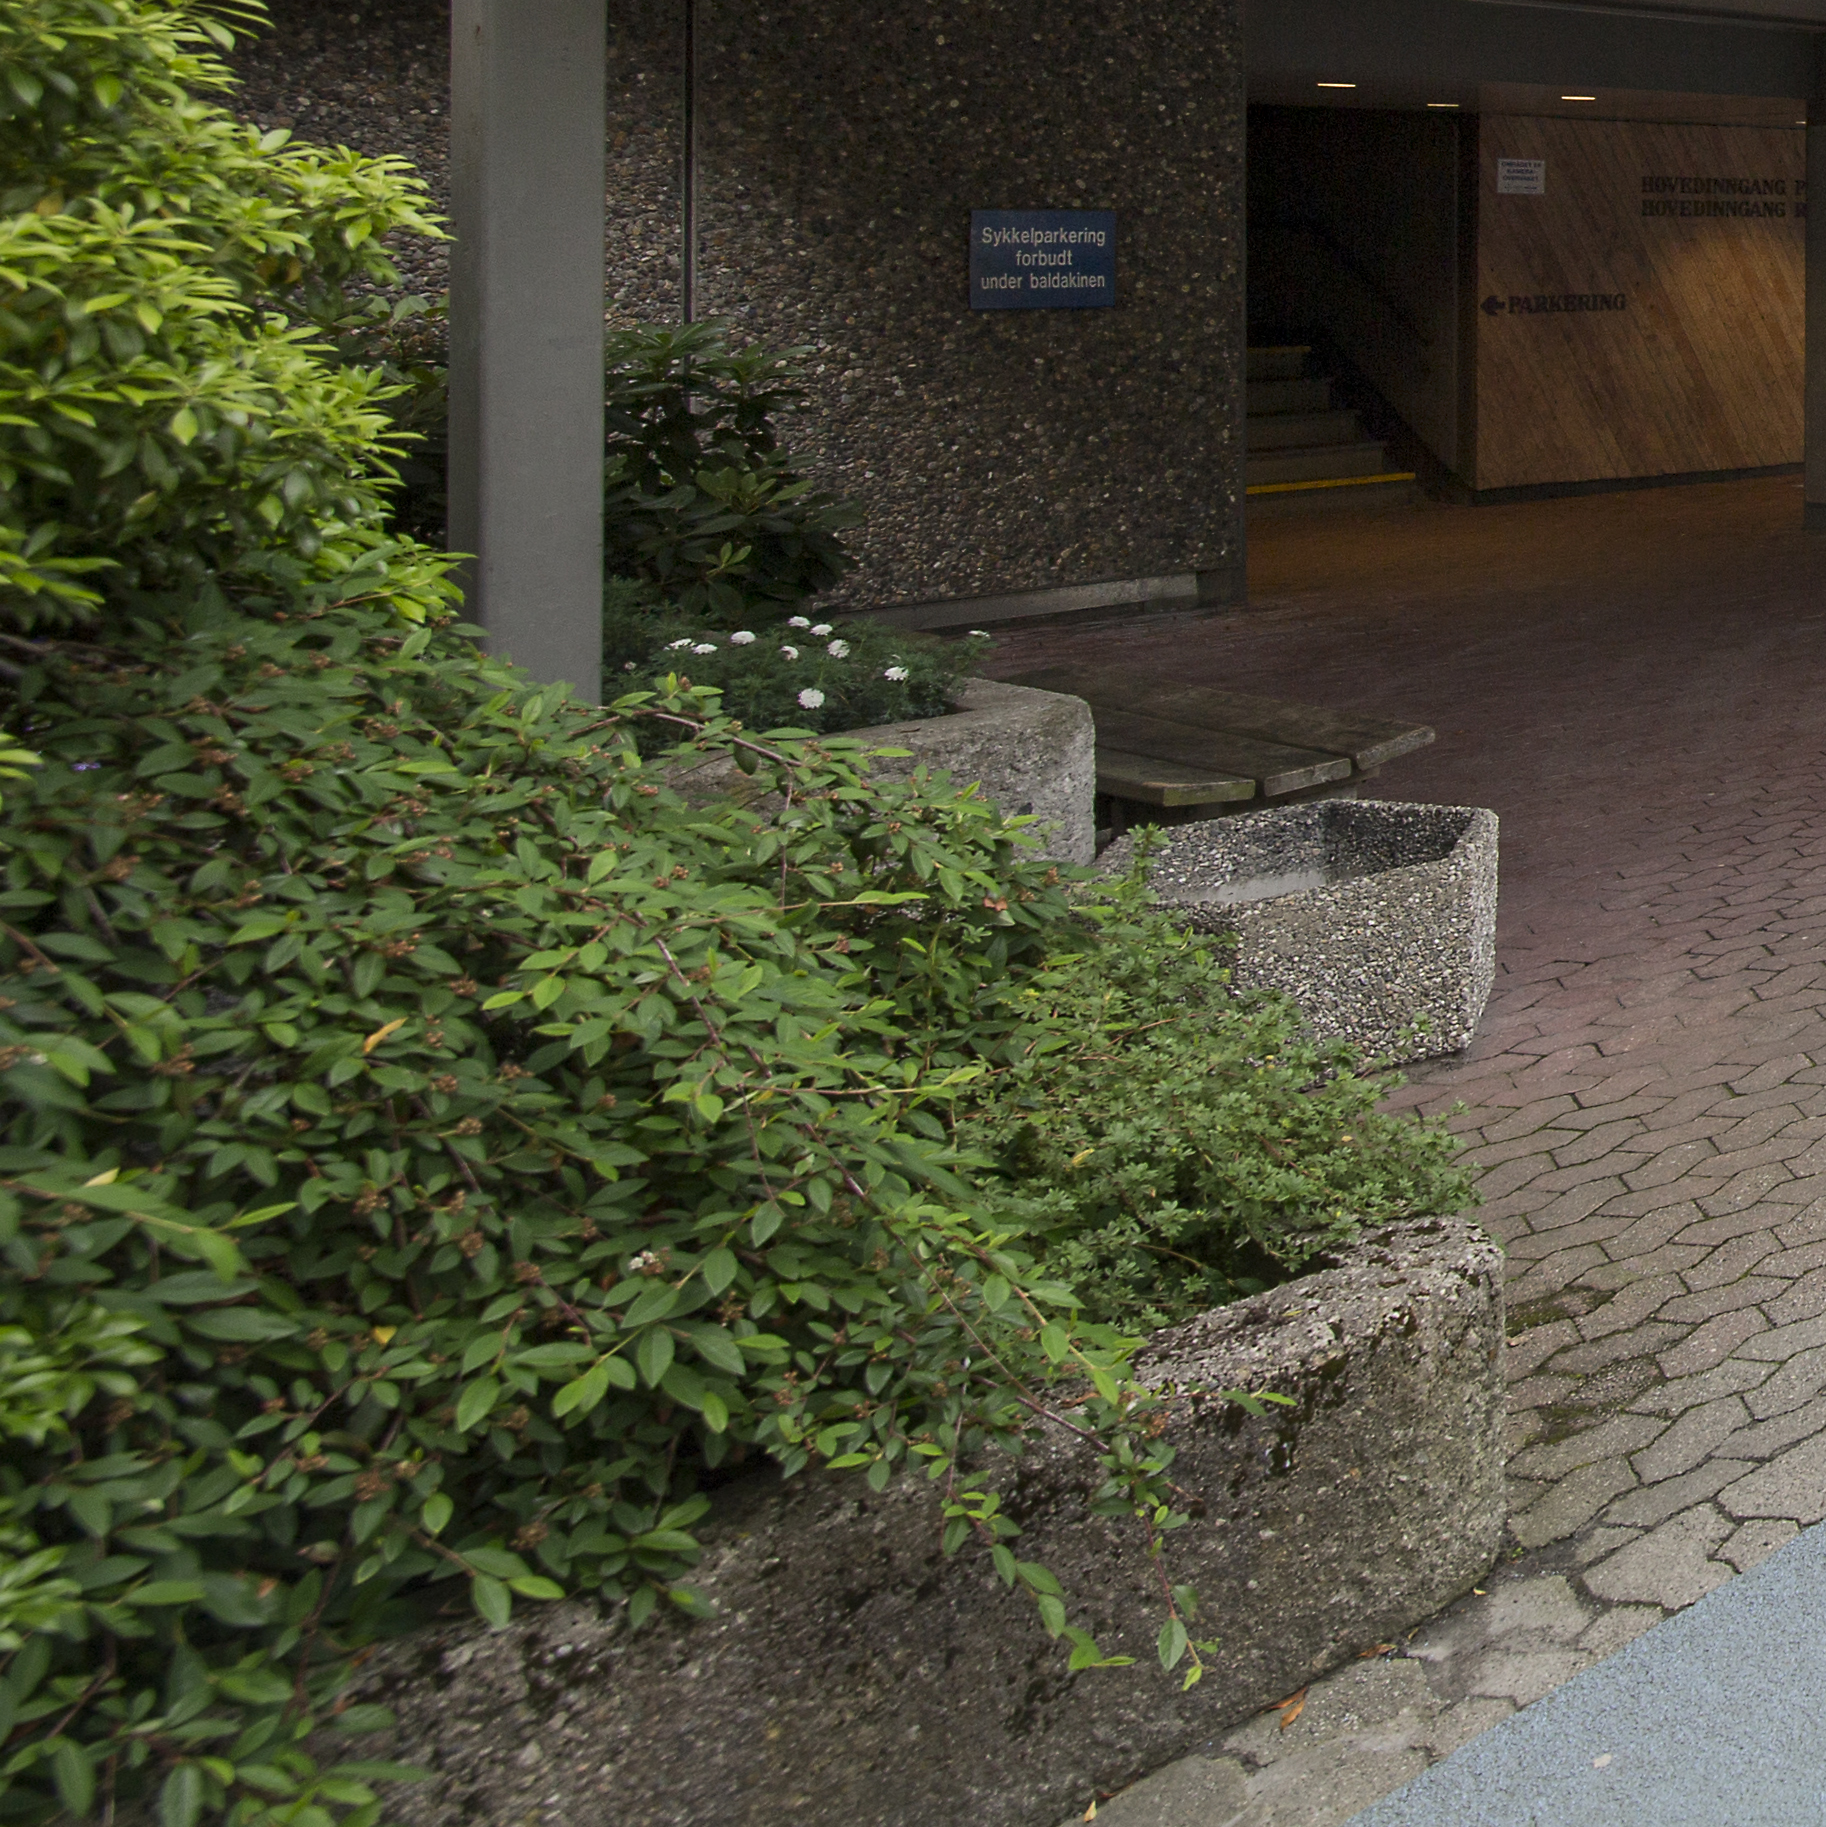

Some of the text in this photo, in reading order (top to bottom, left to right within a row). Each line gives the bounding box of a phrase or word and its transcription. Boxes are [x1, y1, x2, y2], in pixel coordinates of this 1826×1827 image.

[1641, 176, 1786, 195] HOVEDINNGANG
[1641, 199, 1786, 218] HOVEDINNGANG
[981, 227, 1106, 247] Sykkelparkering
[1016, 249, 1073, 266] forbudt
[981, 272, 1106, 290] under baldakinen
[1508, 293, 1626, 314] PARKERING
